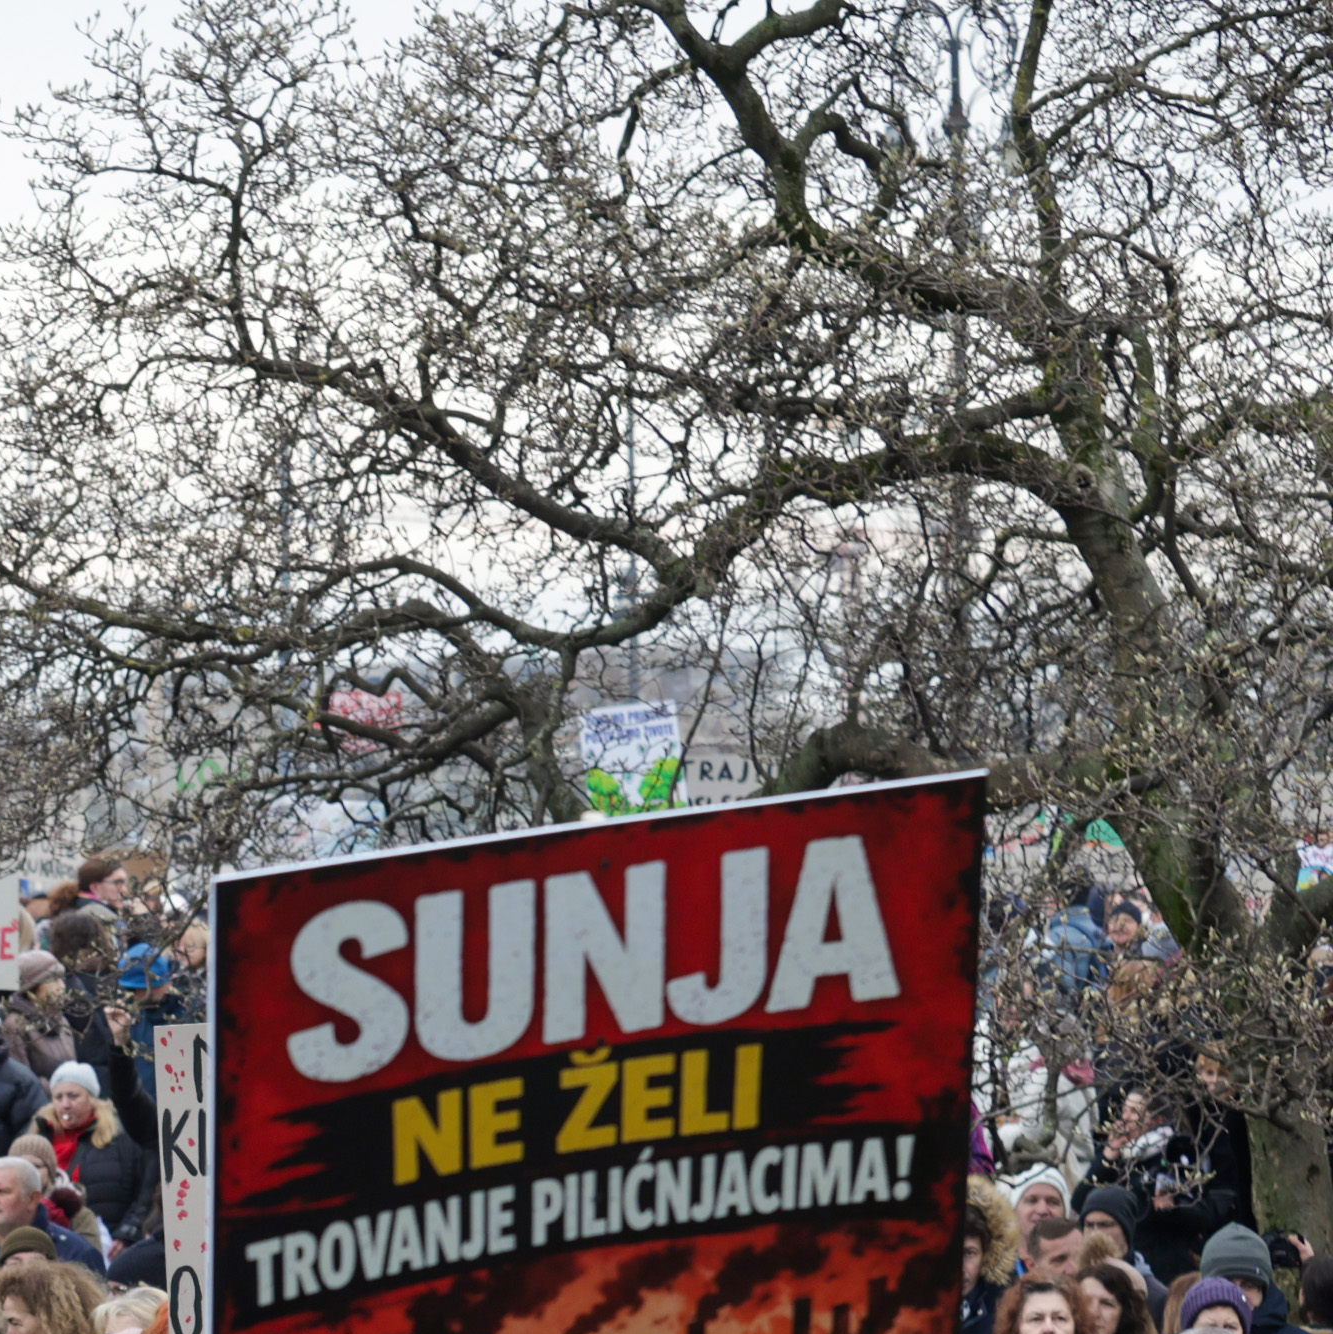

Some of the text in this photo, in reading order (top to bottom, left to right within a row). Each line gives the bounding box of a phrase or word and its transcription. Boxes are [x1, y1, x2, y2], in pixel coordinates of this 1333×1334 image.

[286, 835, 900, 1082] SUNJA
[392, 1043, 763, 1185] NE ŽELI
[245, 1134, 916, 1308] TROVANJE PILIĆNJACIMA!
